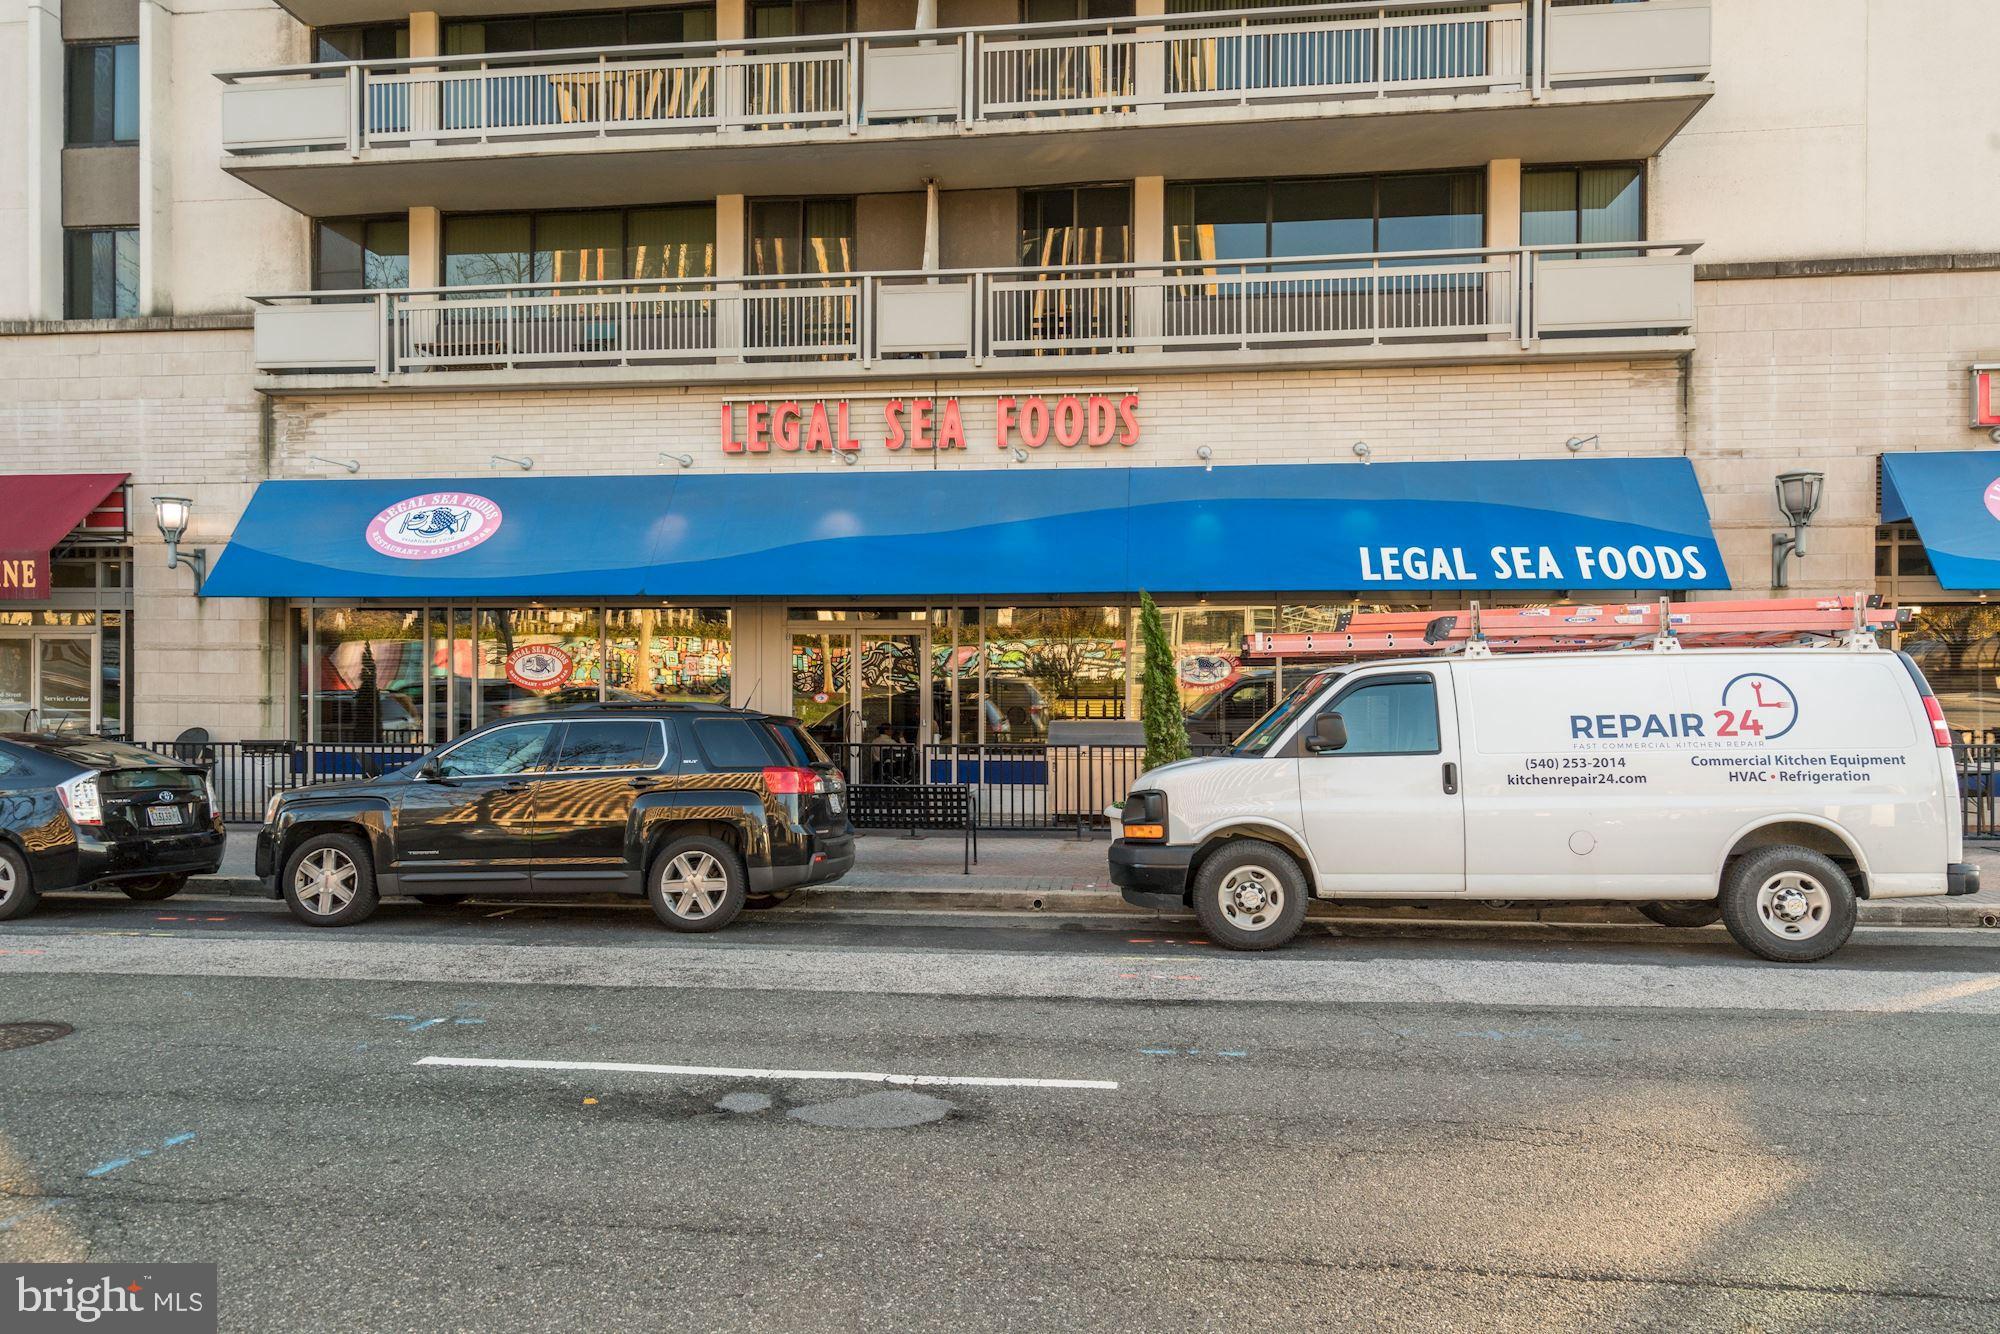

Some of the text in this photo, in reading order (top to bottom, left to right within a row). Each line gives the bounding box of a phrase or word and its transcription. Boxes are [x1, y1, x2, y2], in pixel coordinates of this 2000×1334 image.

[721, 394, 1140, 453] LEGAL SEA FOODS
[376, 494, 499, 523] LEGAL SEA FOODS
[371, 530, 420, 555] RESTAURANT
[430, 540, 471, 555] OYSTER
[473, 527, 492, 541] BAR
[0, 559, 36, 588] NE
[1359, 545, 1707, 580] LEGAL SEA FOODS
[509, 646, 569, 665] LEGAL SEA FOODS
[1570, 709, 1764, 739] REPAIR 24
[1602, 741, 1671, 749] COMMERCIAL
[1726, 740, 1765, 748] REPAIR
[1525, 757, 1626, 770] (540) 253-2014
[1690, 754, 1906, 768] Commercial Kitchen Equipment
[1507, 773, 1647, 787] kitchenrepair24.com
[1729, 770, 1871, 784] HVAC Refrigeration
